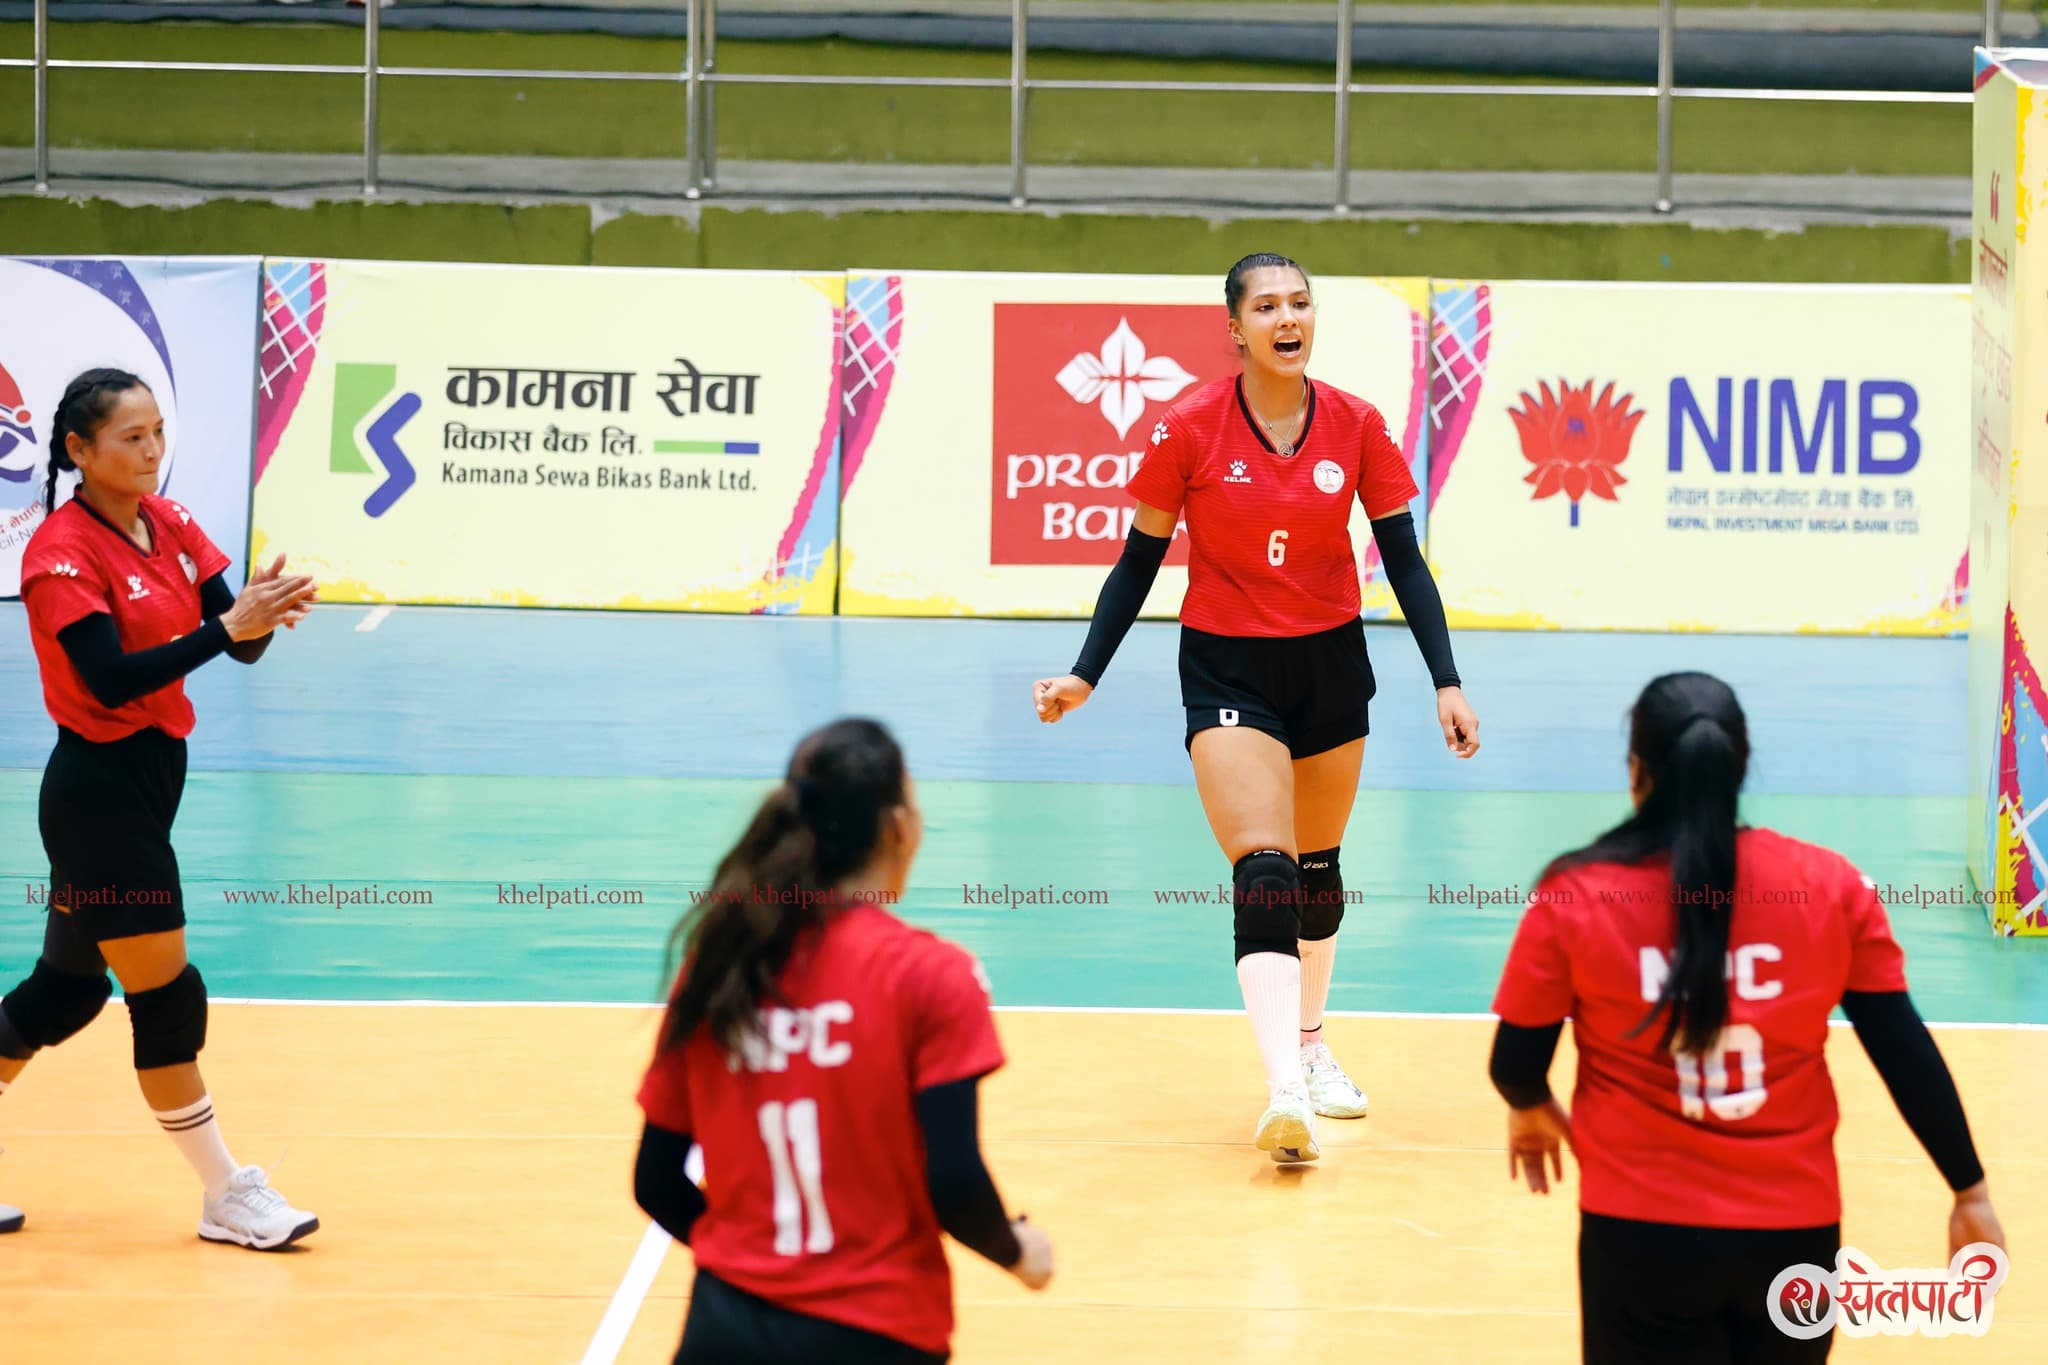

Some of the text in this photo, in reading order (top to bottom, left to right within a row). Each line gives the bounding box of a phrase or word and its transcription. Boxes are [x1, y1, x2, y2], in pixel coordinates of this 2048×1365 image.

[445, 357, 761, 417] कामना सेवा
[443, 421, 533, 454] विकास
[1667, 376, 1922, 475] NIMB
[441, 461, 757, 492] Kamana Sewa Bikas Bank Ltd.
[1223, 475, 1253, 484] KELME
[1267, 529, 1289, 567] 6
[1669, 1023, 1769, 1121] 10
[757, 1097, 834, 1256] 11
